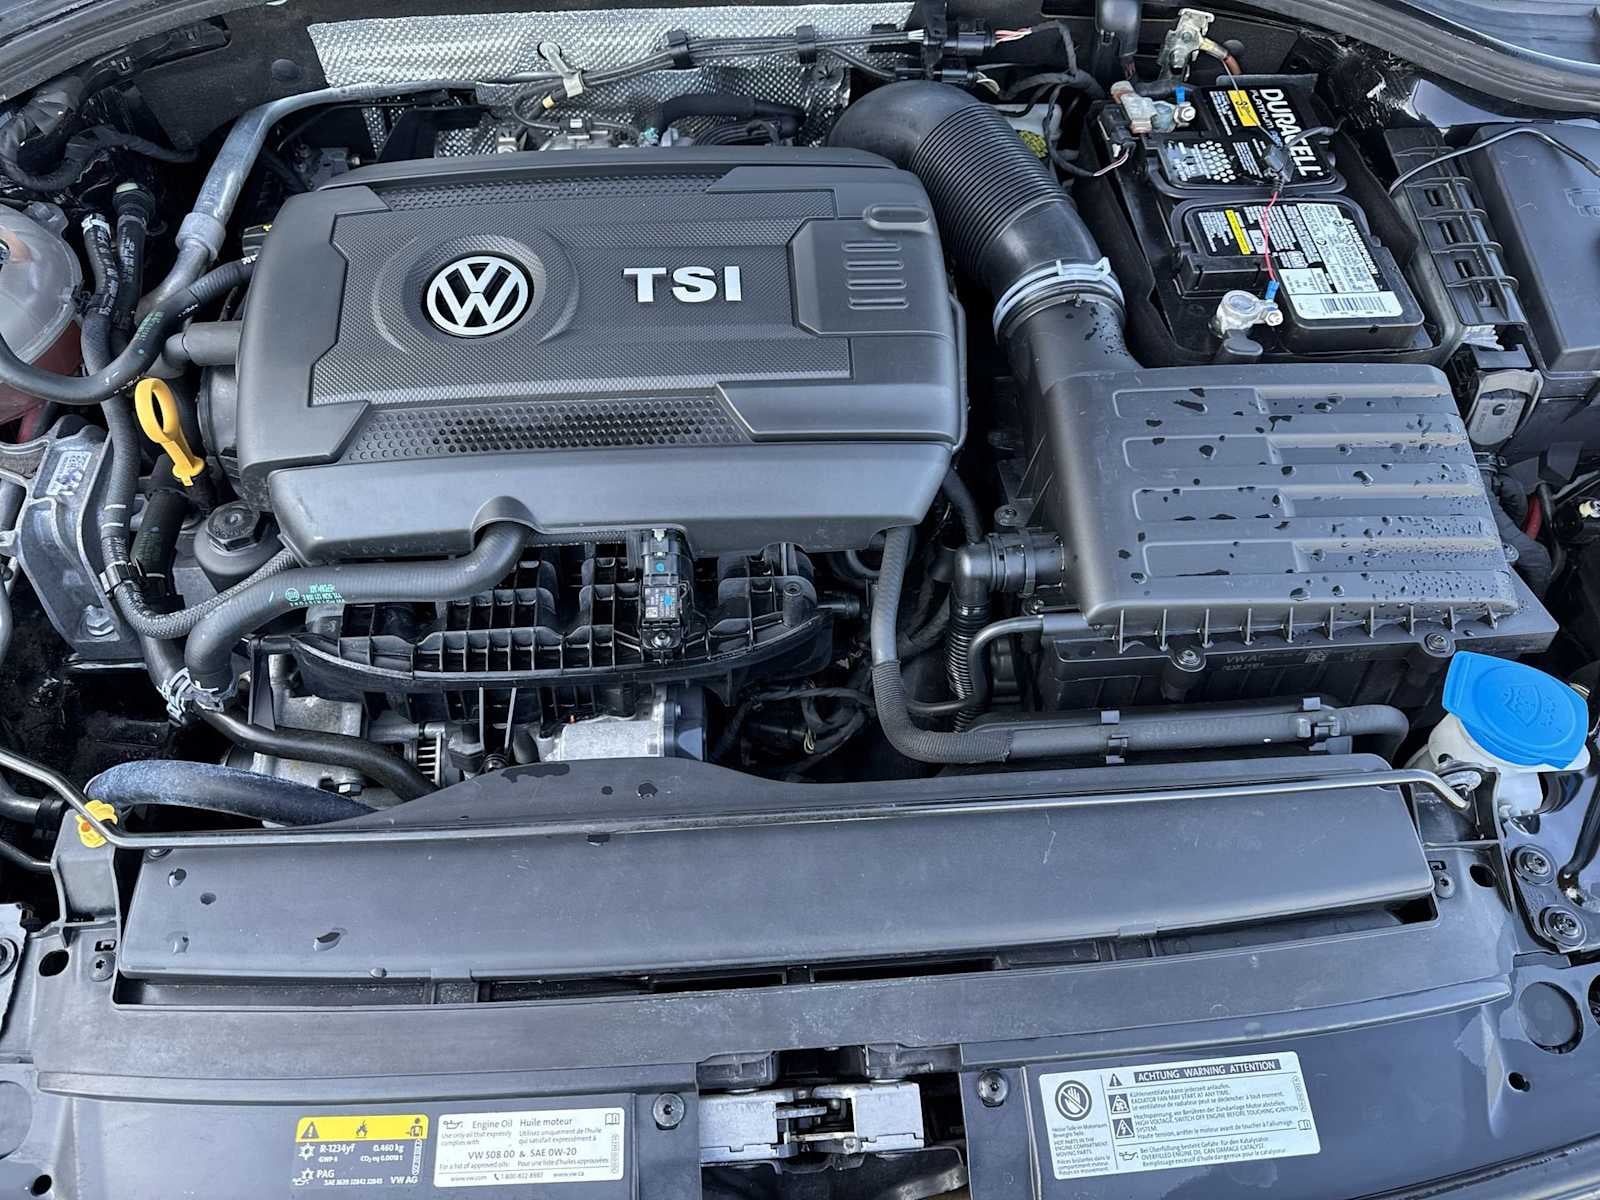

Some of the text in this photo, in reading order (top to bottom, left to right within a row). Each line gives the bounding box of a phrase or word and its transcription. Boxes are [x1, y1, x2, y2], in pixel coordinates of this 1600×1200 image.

[1260, 89, 1321, 176] DURACELL
[624, 266, 742, 303] TSI
[1138, 1060, 1276, 1081] ACHTUNG WARNING ATTENTION
[472, 1119, 513, 1130] Engine Oil
[520, 1117, 573, 1127] Huile moteur
[319, 1143, 356, 1155] R-1234yf
[468, 1151, 484, 1160] VW
[519, 1150, 526, 1158] &
[529, 1148, 547, 1157] SAE
[548, 1147, 577, 1157] 0W-20
[316, 1169, 335, 1179] PAG
[390, 1175, 418, 1184] VW AG
